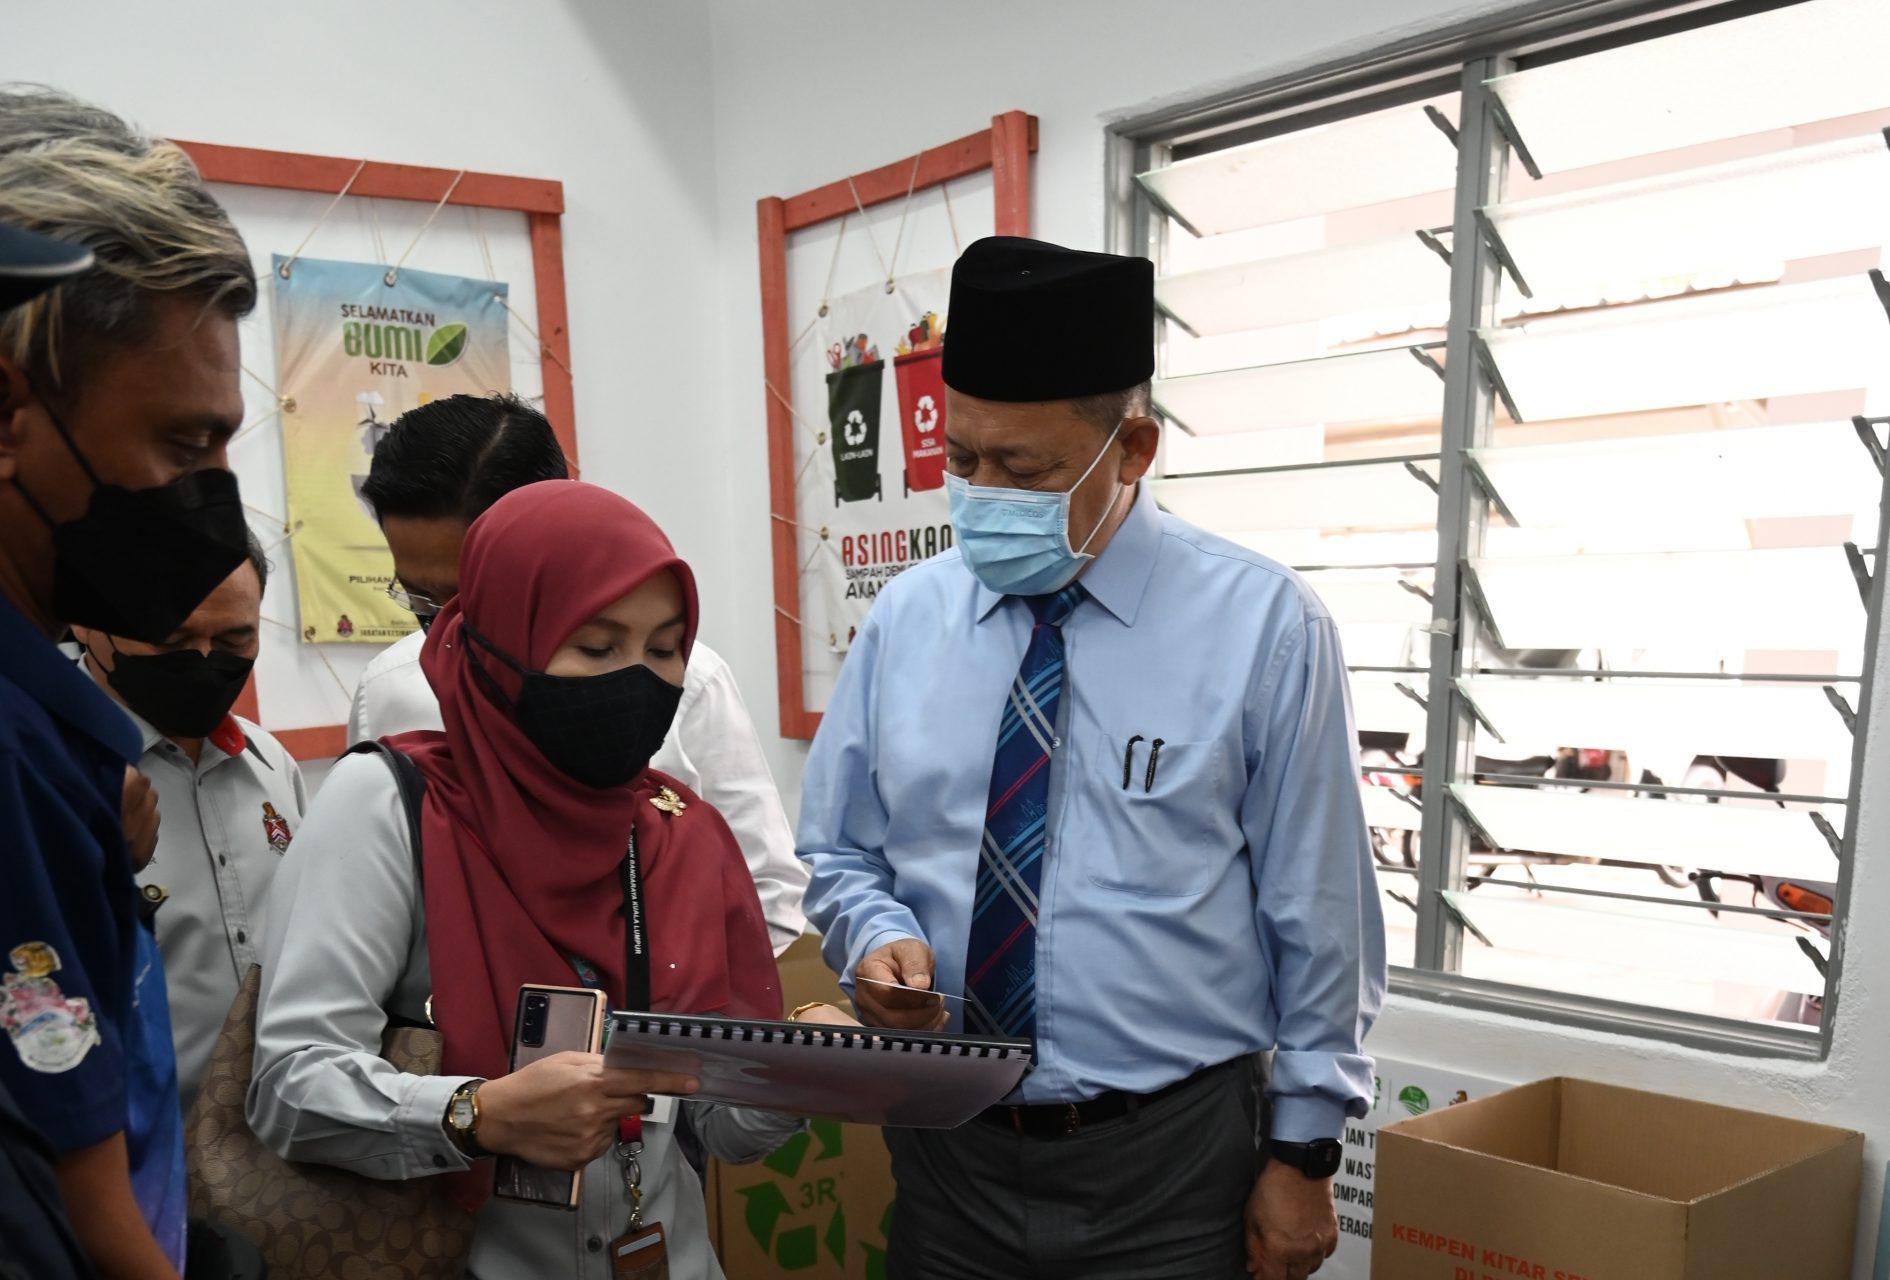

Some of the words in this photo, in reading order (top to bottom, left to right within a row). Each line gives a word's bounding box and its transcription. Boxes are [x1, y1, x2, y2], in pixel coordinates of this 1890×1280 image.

[341, 303, 435, 327] SELAMATKAN
[343, 321, 423, 363] BUMI
[370, 362, 408, 378] KITA
[845, 566, 883, 580] SAMPAH
[632, 901, 641, 925] KUALA
[633, 924, 642, 956] LUMPUR
[1345, 1158, 1376, 1181] WAS
[799, 1177, 838, 1209] 3R
[1337, 1214, 1373, 1239] ERAG
[1392, 1223, 1475, 1261] KEMPEN
